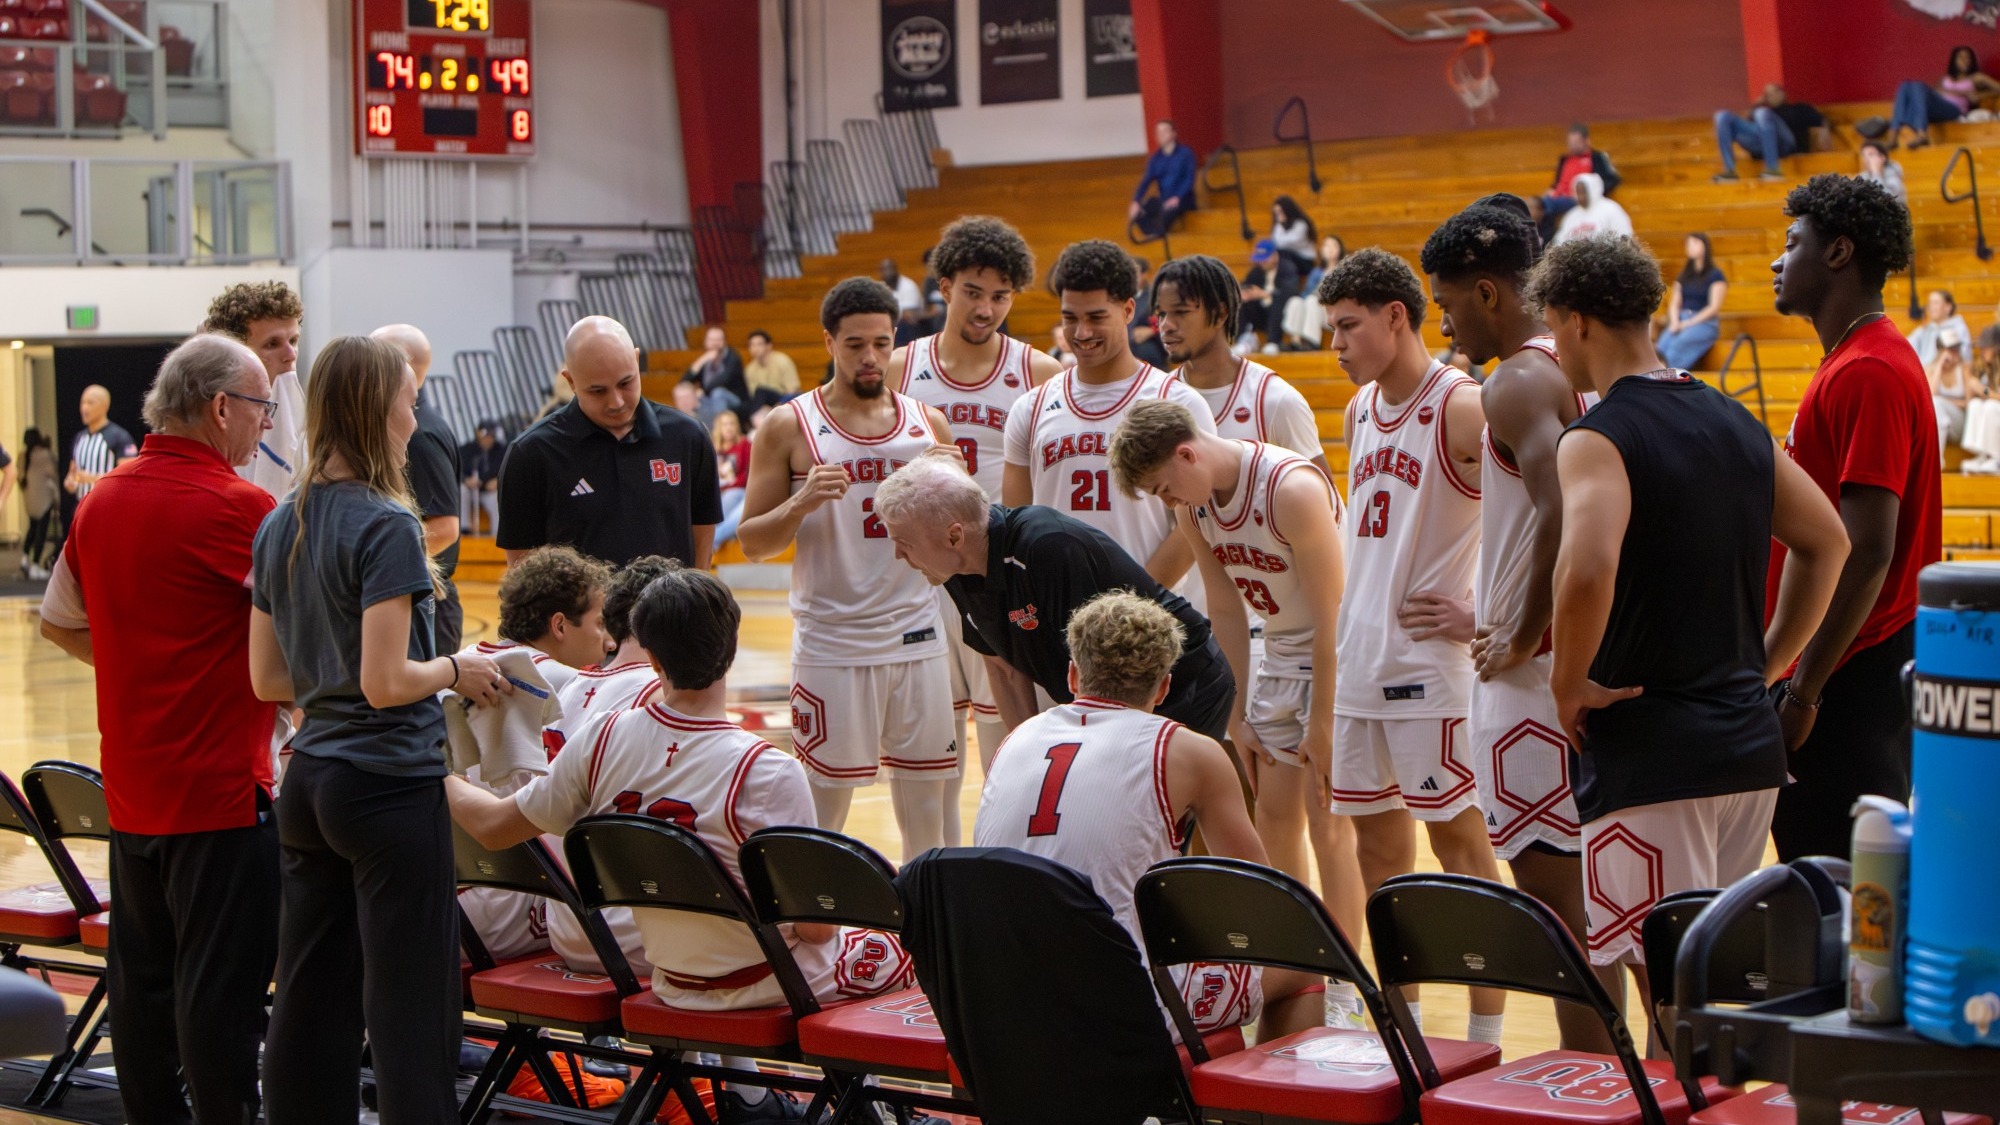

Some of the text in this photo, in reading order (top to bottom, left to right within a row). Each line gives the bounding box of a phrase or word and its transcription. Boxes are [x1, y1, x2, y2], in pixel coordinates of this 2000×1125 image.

[428, 0, 489, 32] 7:29
[377, 52, 414, 89] 74
[441, 59, 458, 91] 2
[491, 59, 529, 94] 49
[369, 105, 392, 136] 10
[512, 110, 530, 141] 8
[932, 402, 1009, 432] GLE
[1043, 432, 1113, 471] EAGL
[649, 459, 682, 485] BU
[1071, 470, 1111, 511] 21
[1357, 491, 1391, 538] 13
[1212, 543, 1289, 574] AGLES
[1235, 578, 1280, 615] 23
[792, 706, 811, 736] BU
[1027, 742, 1082, 837] 1
[851, 938, 888, 982] BU
[1192, 973, 1226, 1021] BU
[1494, 1059, 1667, 1105] BU
